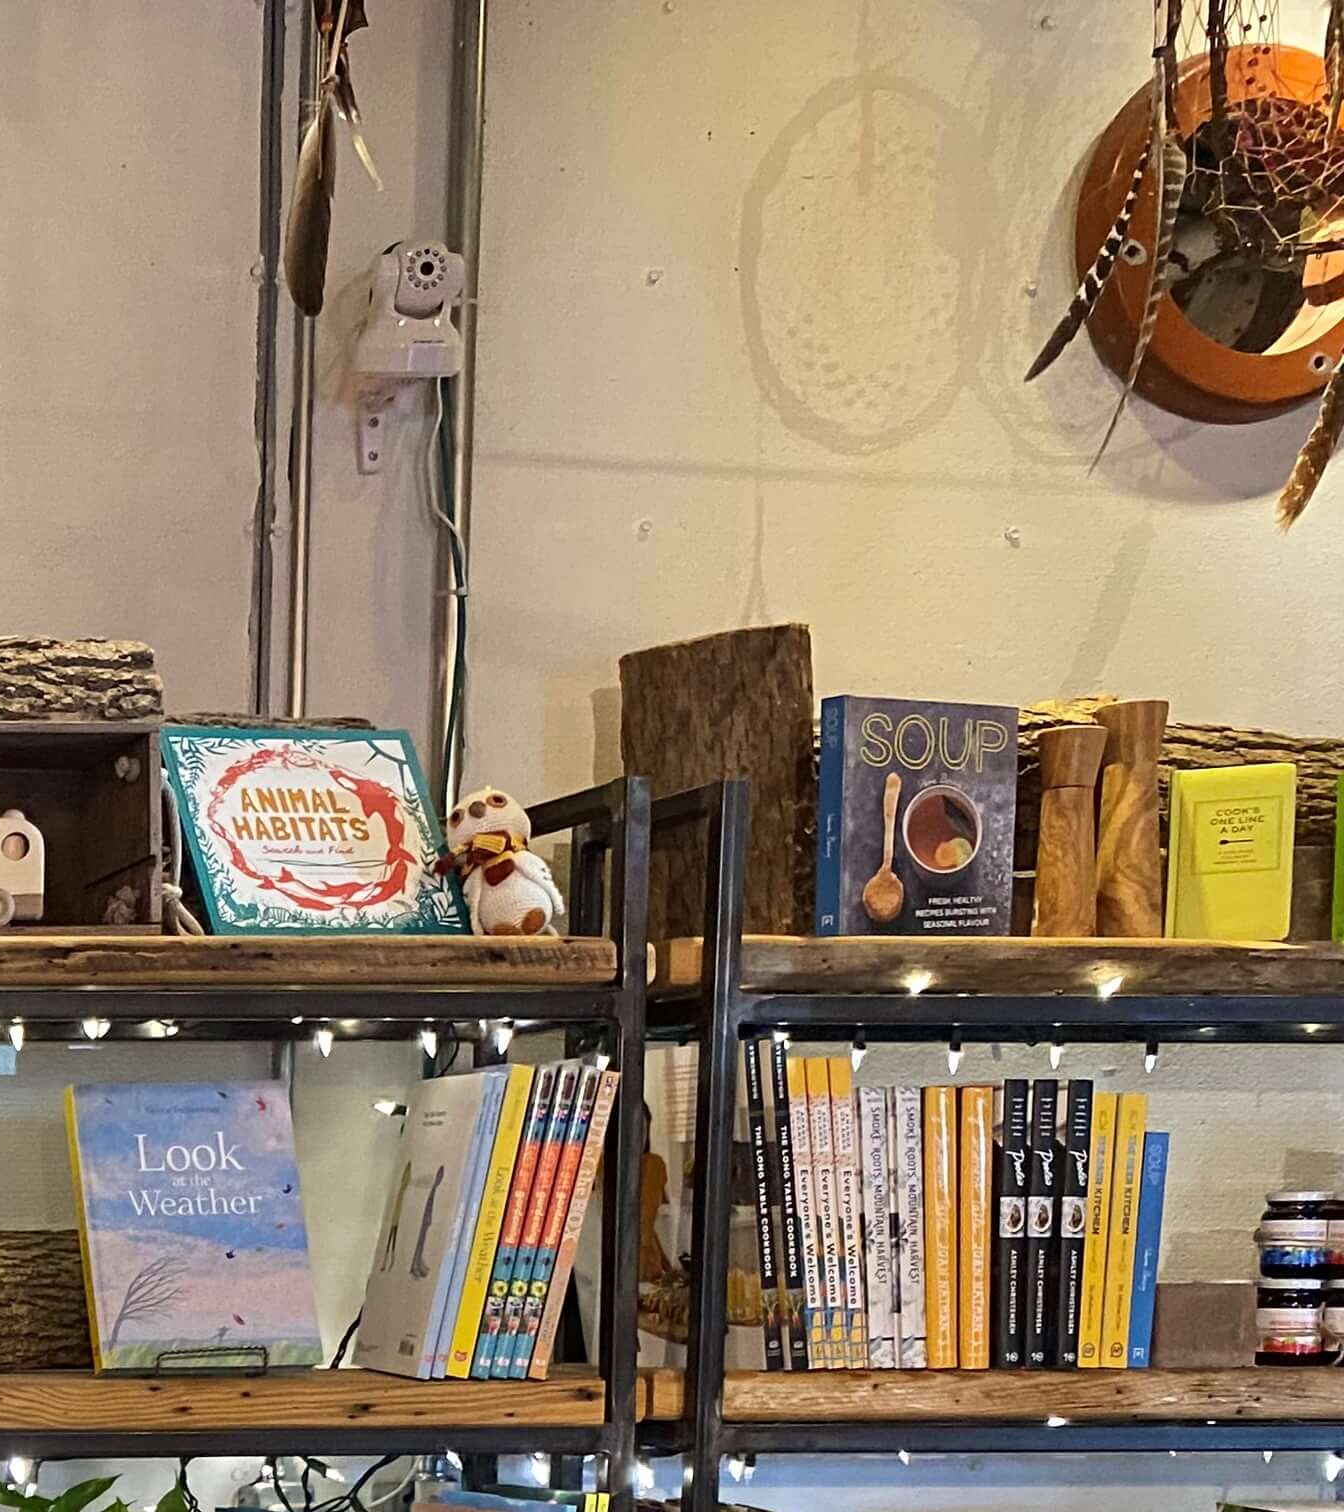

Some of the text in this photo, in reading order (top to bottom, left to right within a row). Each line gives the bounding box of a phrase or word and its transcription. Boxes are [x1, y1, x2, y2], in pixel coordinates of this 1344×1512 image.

[861, 713, 1008, 773] SOUP
[240, 788, 351, 813] ANIMAL
[1216, 807, 1260, 816] COOK'S
[232, 816, 371, 842] HABITATS
[1232, 825, 1254, 833] DAY
[1238, 815, 1265, 824] LINE
[780, 1126, 788, 1145] THE
[134, 1131, 245, 1173] Look
[781, 1149, 790, 1180] LONG
[172, 1173, 211, 1187] at the
[127, 1188, 262, 1217] Weather
[784, 1183, 793, 1214] TABLE
[799, 1170, 816, 1304] Everyone's Welcome
[843, 1170, 857, 1304] Everyone's Welcome
